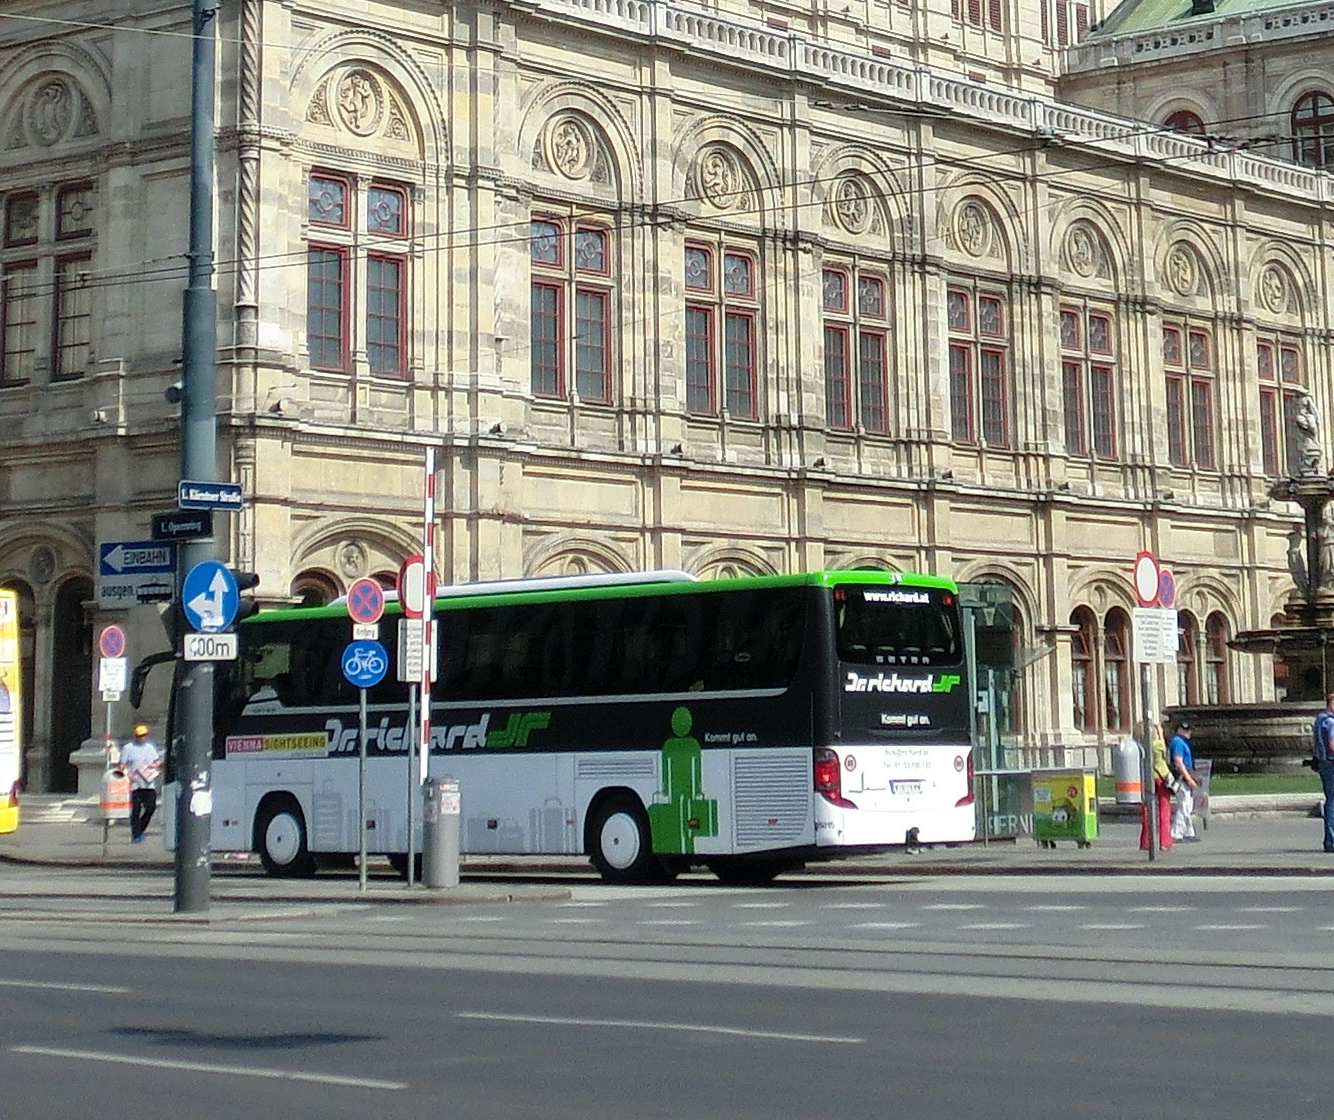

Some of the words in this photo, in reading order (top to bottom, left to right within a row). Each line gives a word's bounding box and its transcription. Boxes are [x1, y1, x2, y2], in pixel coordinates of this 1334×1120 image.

[124, 548, 166, 565] EINBAHN
[101, 585, 135, 600] ausgen.
[863, 591, 930, 604] www.richard.at
[228, 739, 262, 752] VIENNA
[264, 736, 325, 750] SIGHTSEEING
